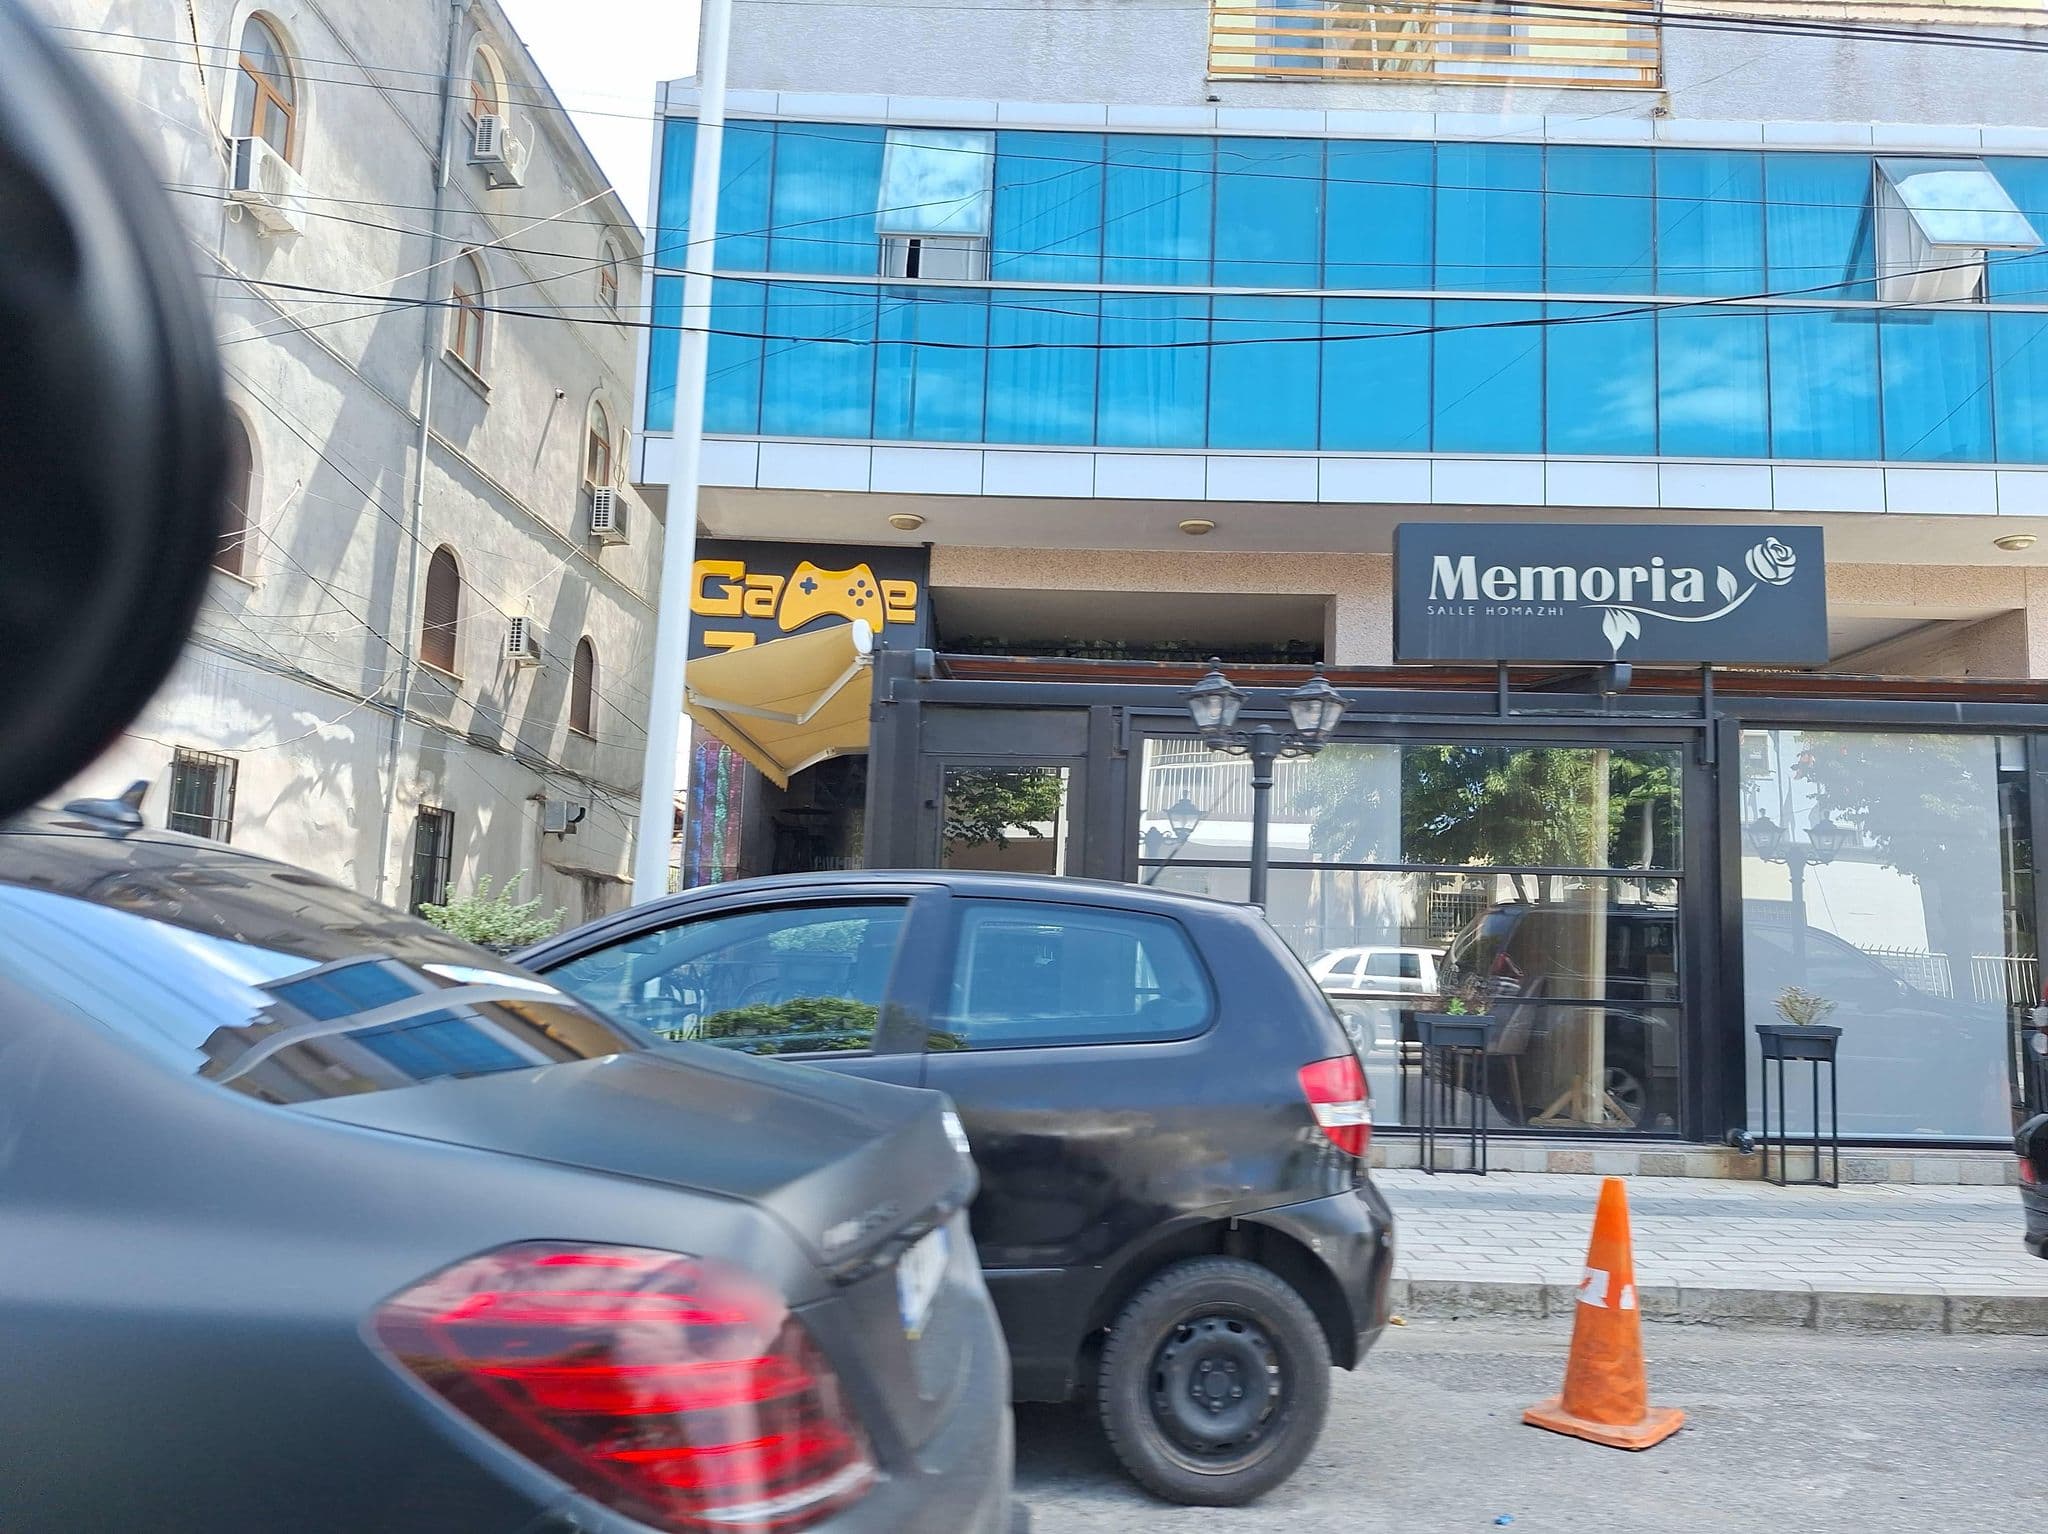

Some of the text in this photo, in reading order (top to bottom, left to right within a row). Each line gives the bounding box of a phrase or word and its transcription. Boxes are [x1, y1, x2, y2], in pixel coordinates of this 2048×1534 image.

[1429, 555, 1704, 602] Memoria
[1427, 605, 1564, 616] SALLE HOMAZHI
